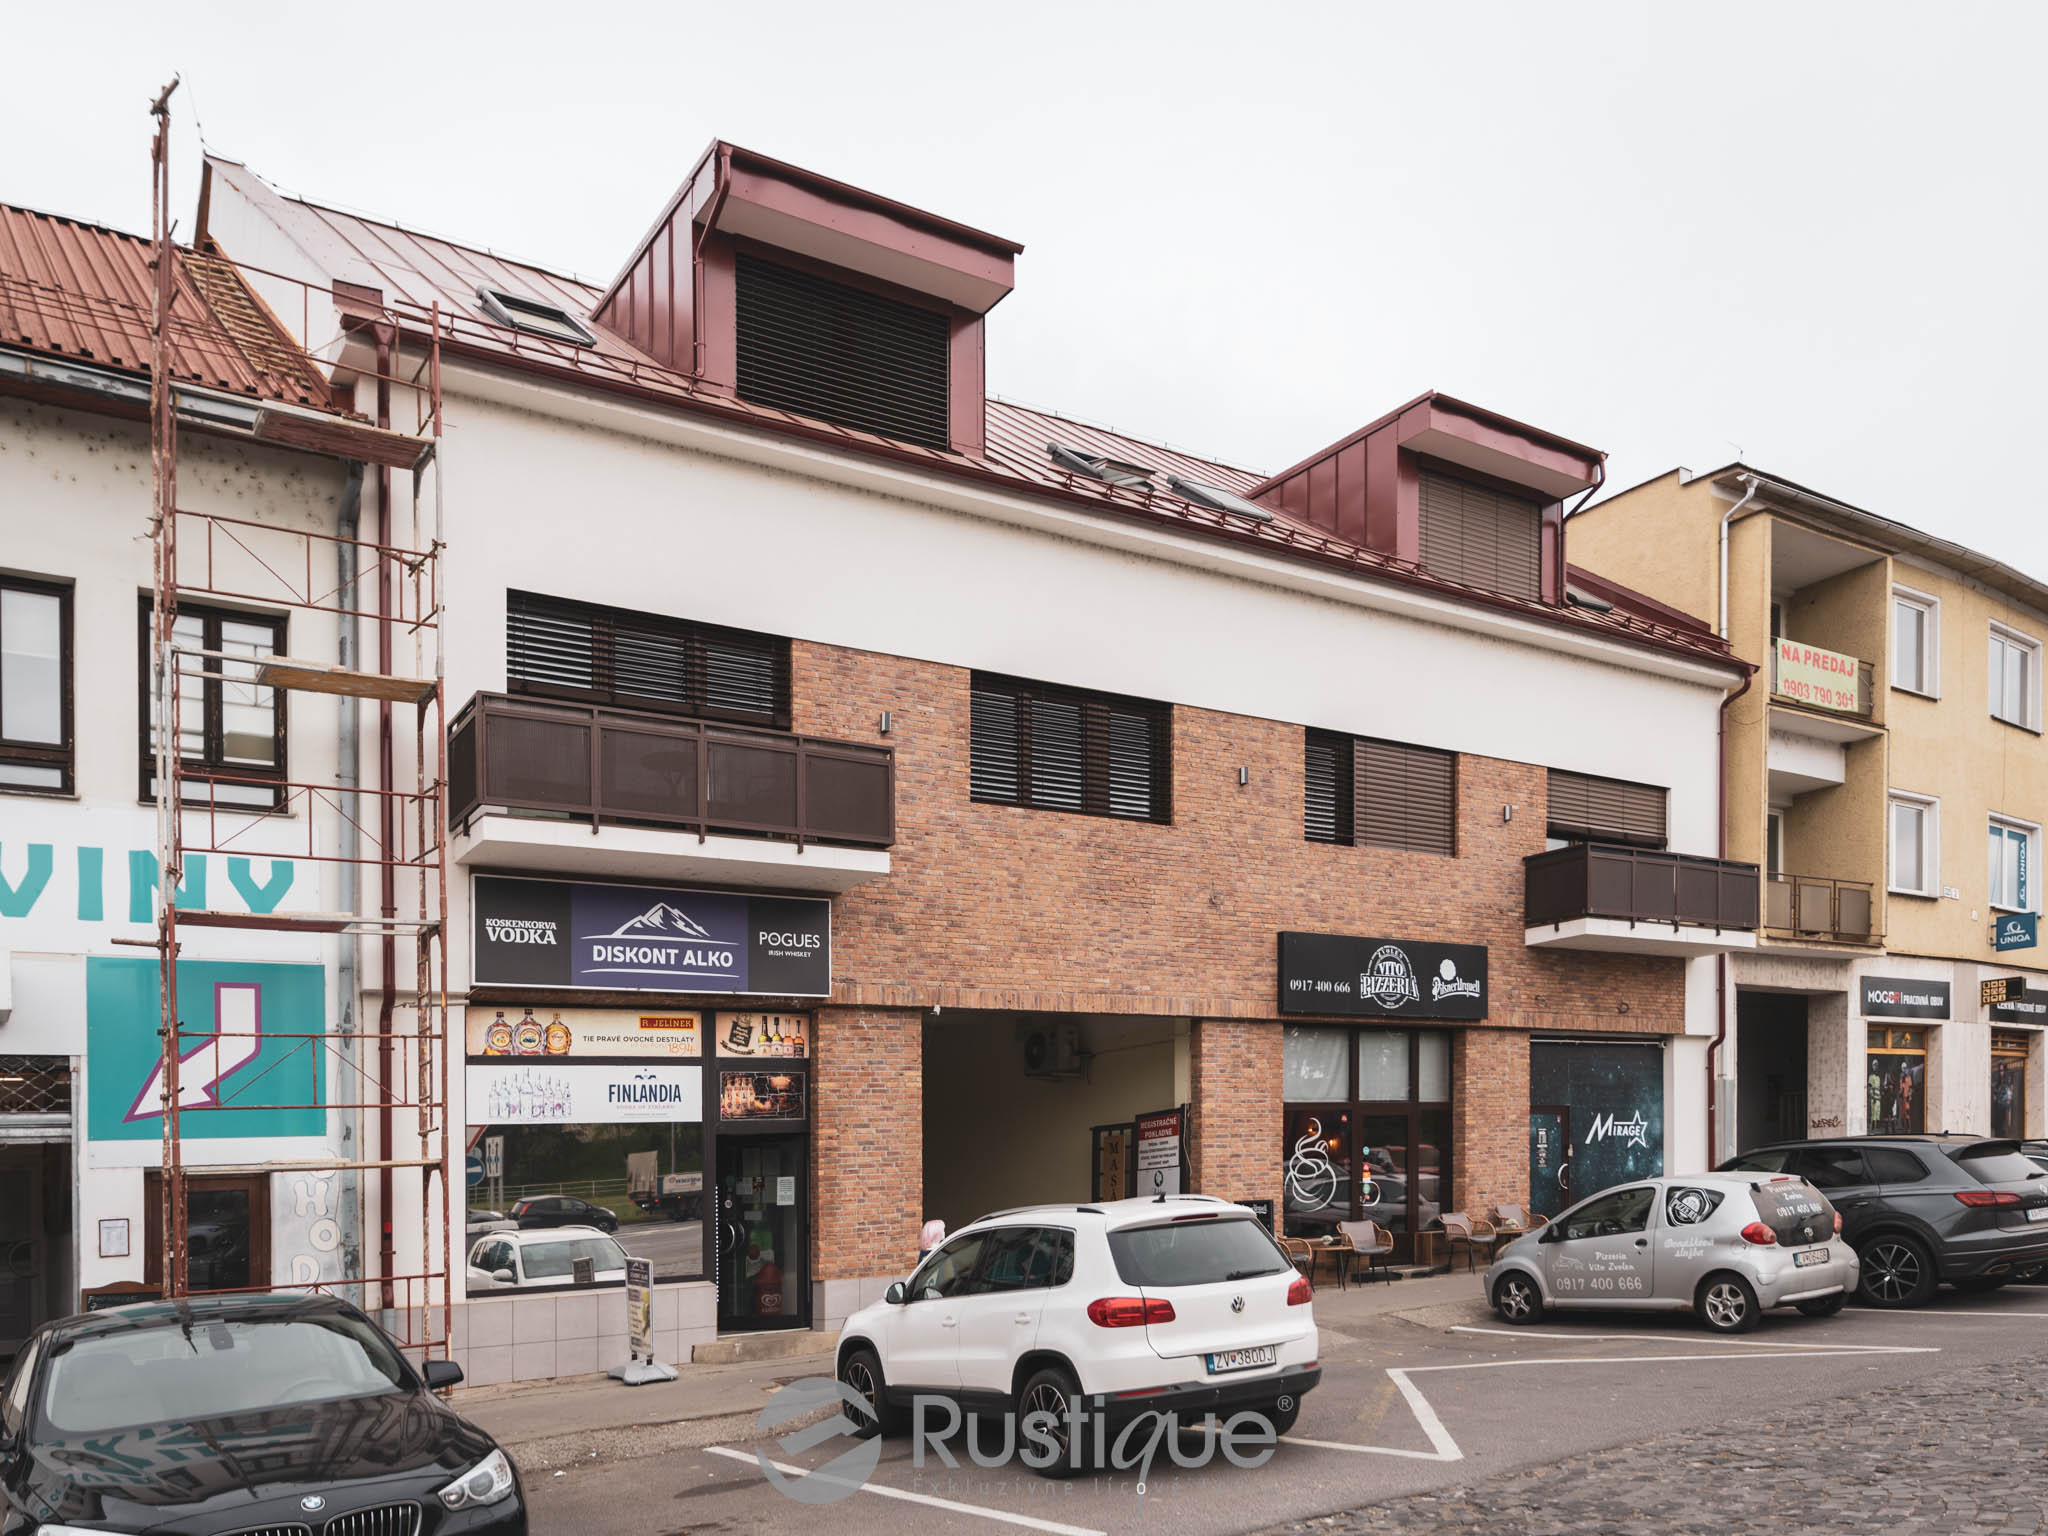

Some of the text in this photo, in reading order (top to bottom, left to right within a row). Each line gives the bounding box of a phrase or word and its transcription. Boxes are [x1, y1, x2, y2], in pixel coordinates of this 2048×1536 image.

[1781, 643, 1854, 677] NA PREDAJ
[1783, 677, 1854, 708] 0903 790 301
[485, 918, 557, 930] KOSKENKORVA
[485, 926, 557, 945] VODKA
[759, 931, 820, 948] POGUES
[1999, 933, 2031, 945] UNIQA
[592, 945, 733, 968] DISKONT ALKO
[1379, 961, 1403, 976] VITO
[1290, 979, 1351, 993] 0917 400 666
[1362, 976, 1417, 998] PIZZERIA
[623, 1035, 655, 1043] OVOCNÉ
[668, 1043, 695, 1056] 1894
[608, 1084, 682, 1103] FINLANDIA
[1556, 1276, 1642, 1290] 0917 400 666
[1215, 1352, 1230, 1369] ZV
